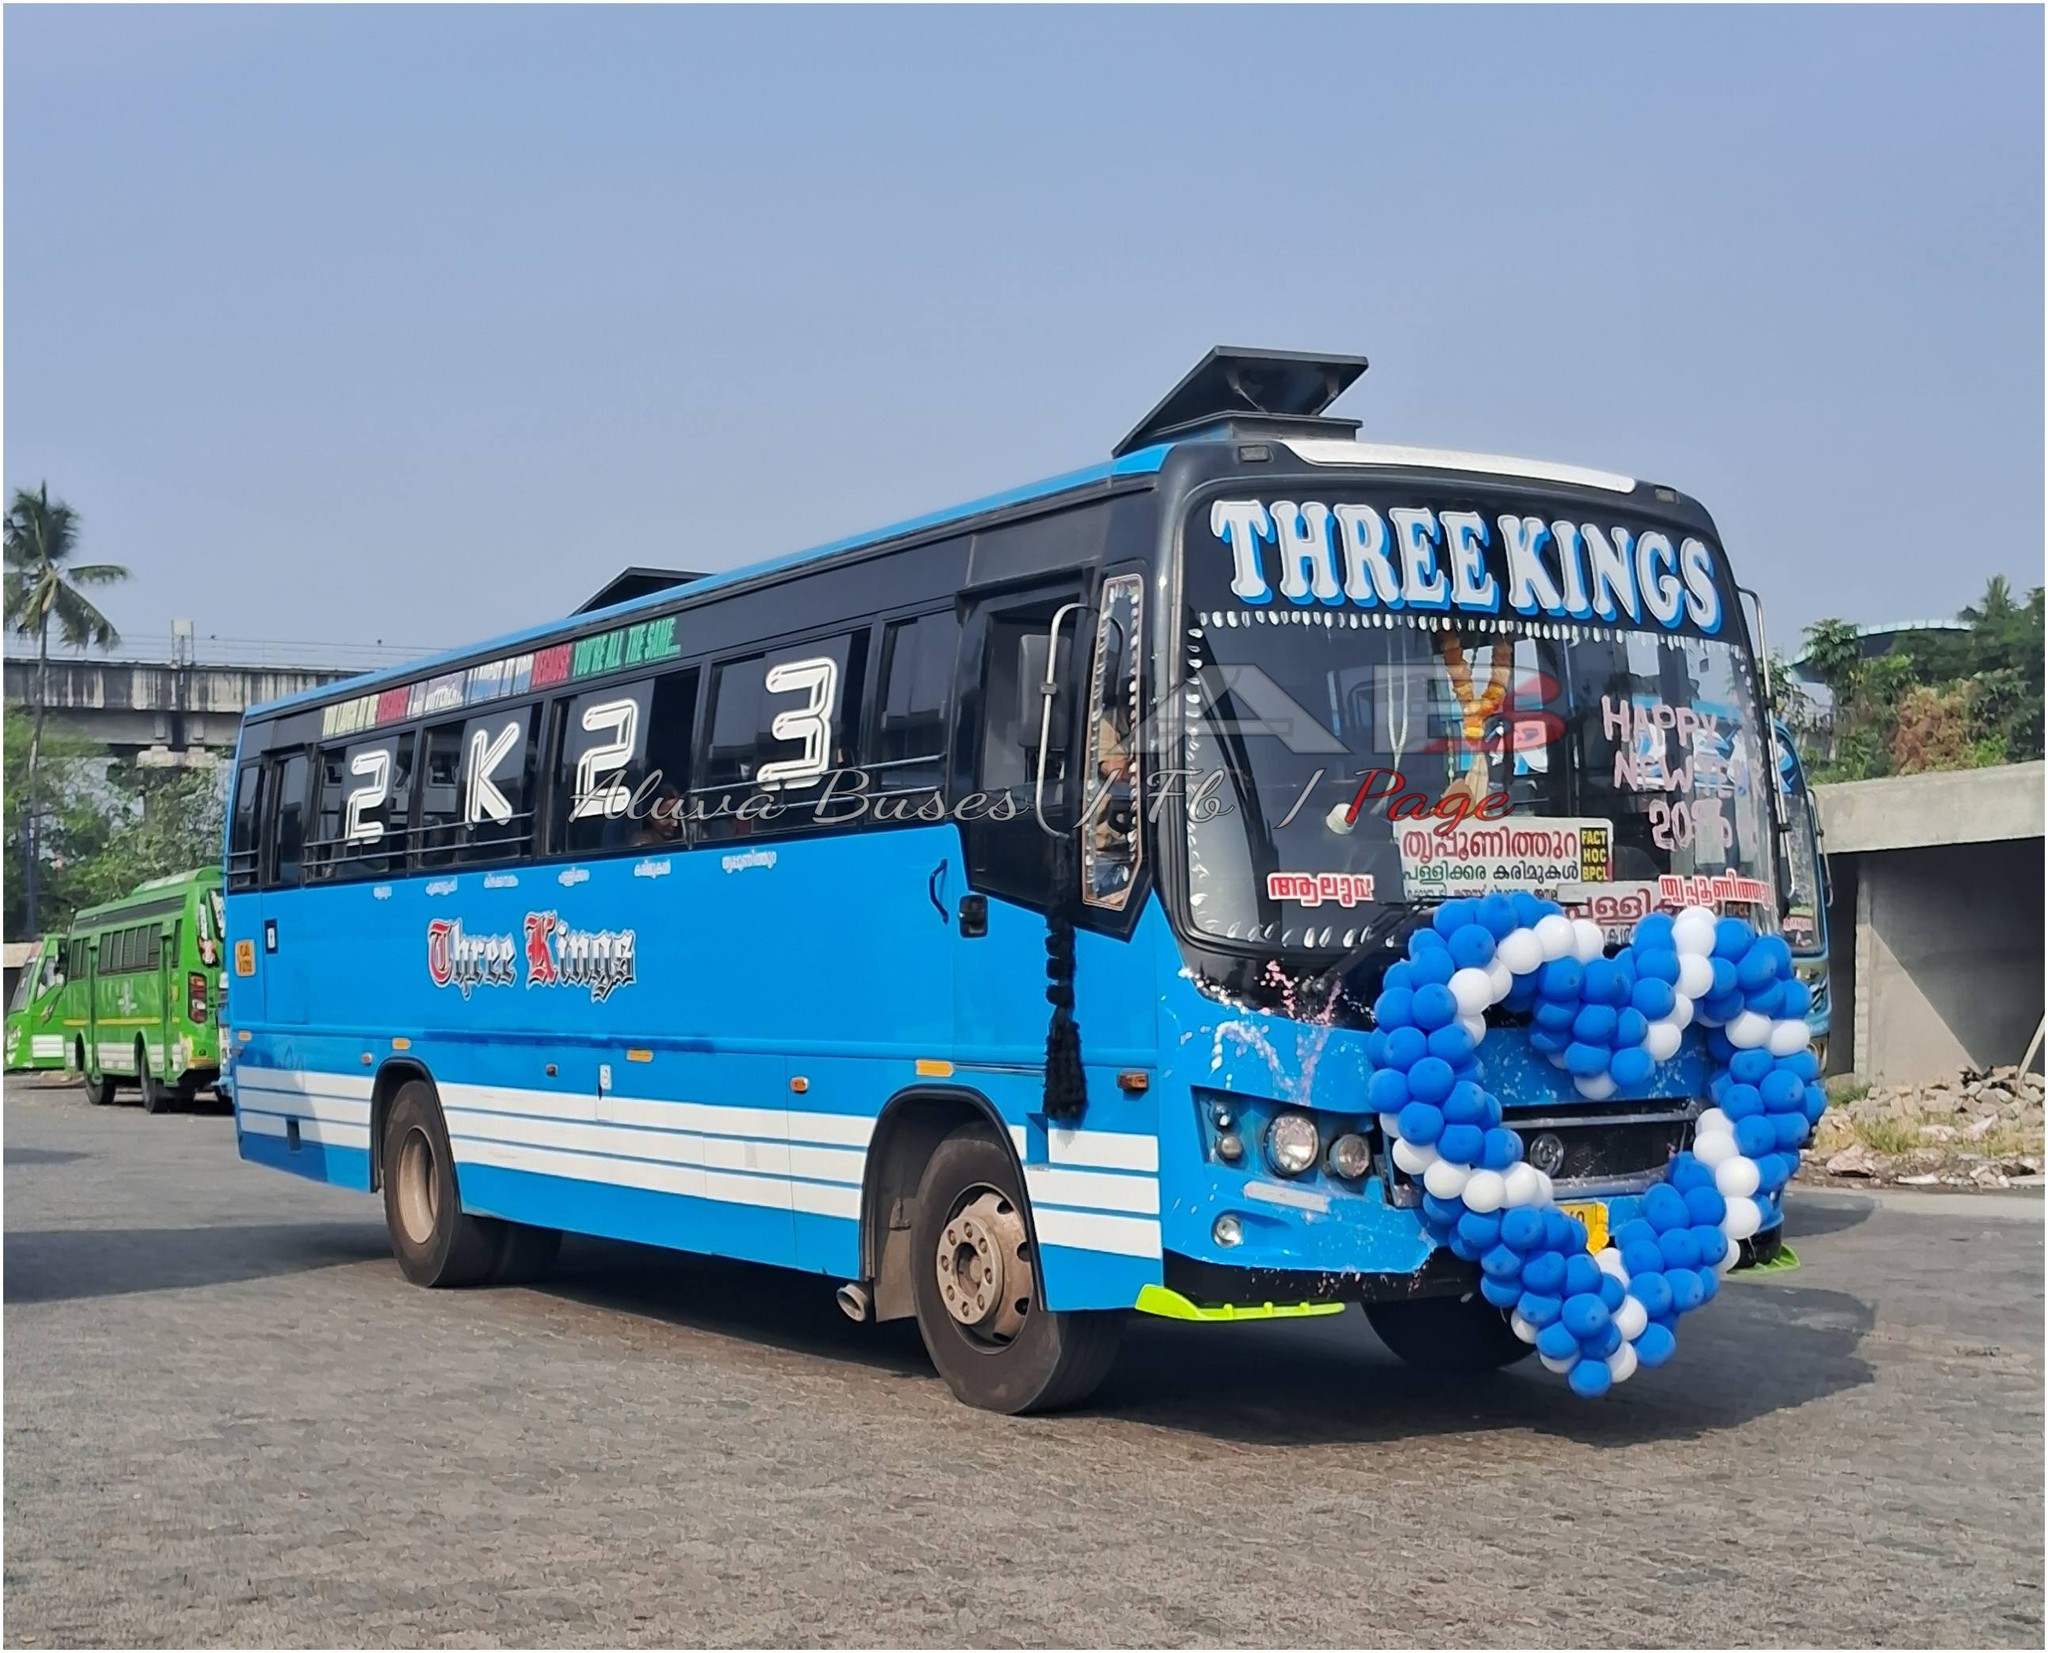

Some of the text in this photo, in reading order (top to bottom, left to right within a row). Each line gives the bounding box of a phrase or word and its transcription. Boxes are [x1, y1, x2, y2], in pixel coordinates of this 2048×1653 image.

[1210, 499, 1722, 635] THREE KINGS
[464, 721, 521, 831] K
[756, 656, 838, 791] 3
[1581, 830, 1607, 845] FACT
[1583, 848, 1607, 863] HOC
[1402, 859, 1579, 885] പള്ളിക്കര കരിമുകൾ
[1582, 866, 1608, 881] BPCL
[1268, 873, 1375, 906] ആലുവ
[428, 909, 637, 1004] Three Kings
